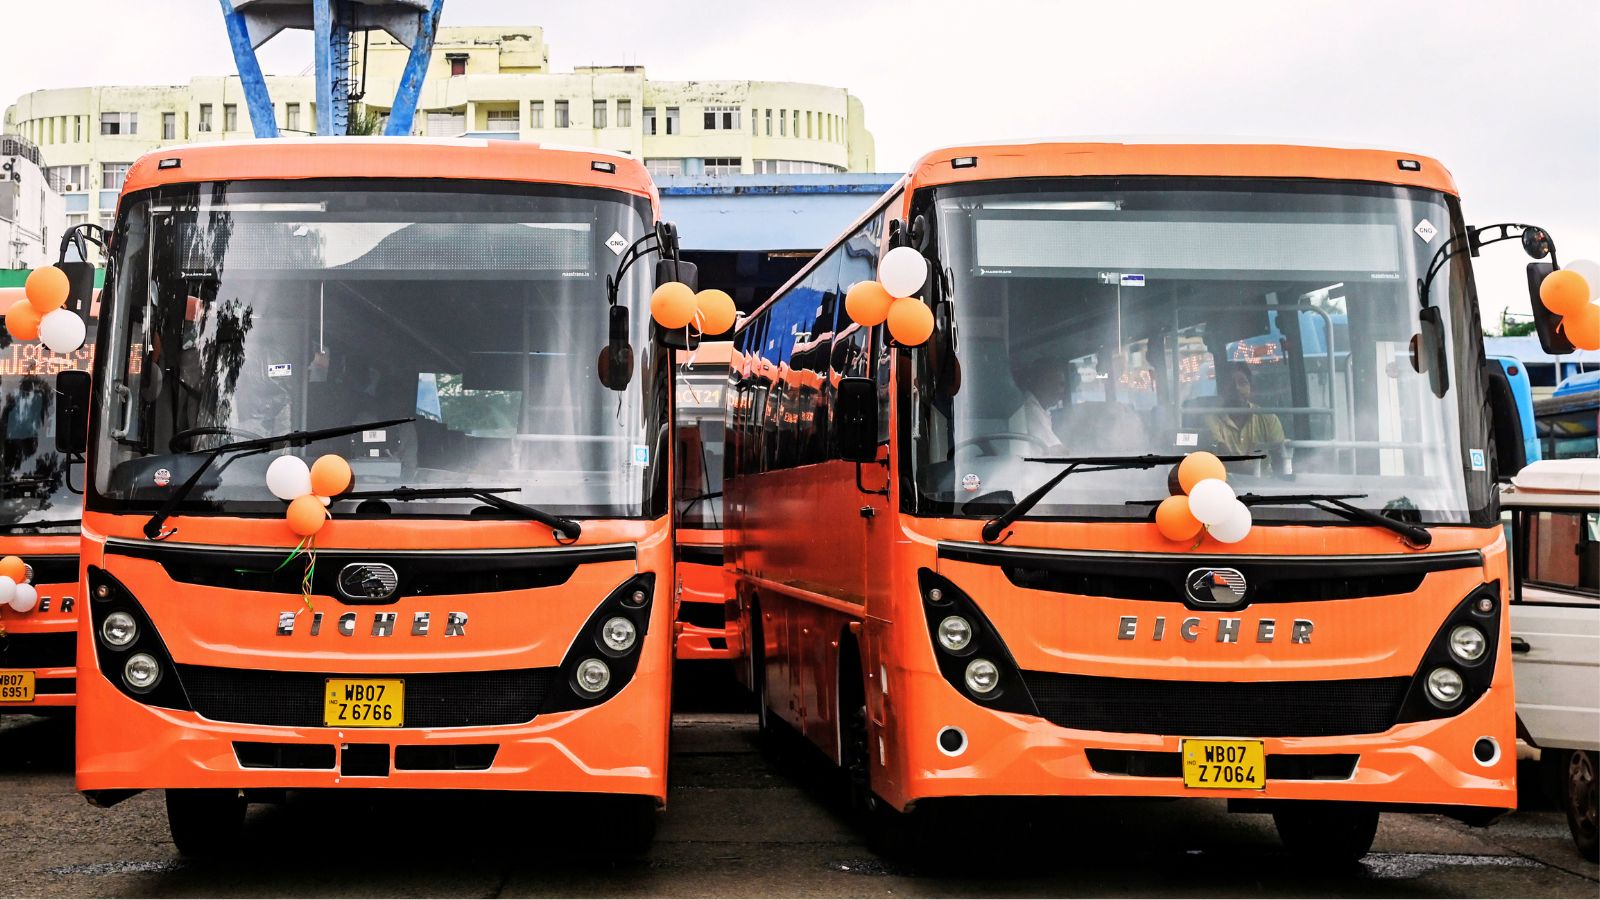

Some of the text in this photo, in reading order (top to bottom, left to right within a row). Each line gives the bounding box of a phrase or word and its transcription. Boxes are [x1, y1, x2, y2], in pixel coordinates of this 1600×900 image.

[276, 611, 469, 637] EICHER
[1117, 616, 1314, 644] EICHER
[2, 686, 28, 698] 6951
[345, 684, 386, 702] WB07
[338, 703, 392, 720] Z 6766
[1204, 745, 1247, 764] WB07
[1198, 765, 1255, 783] Z 7064
